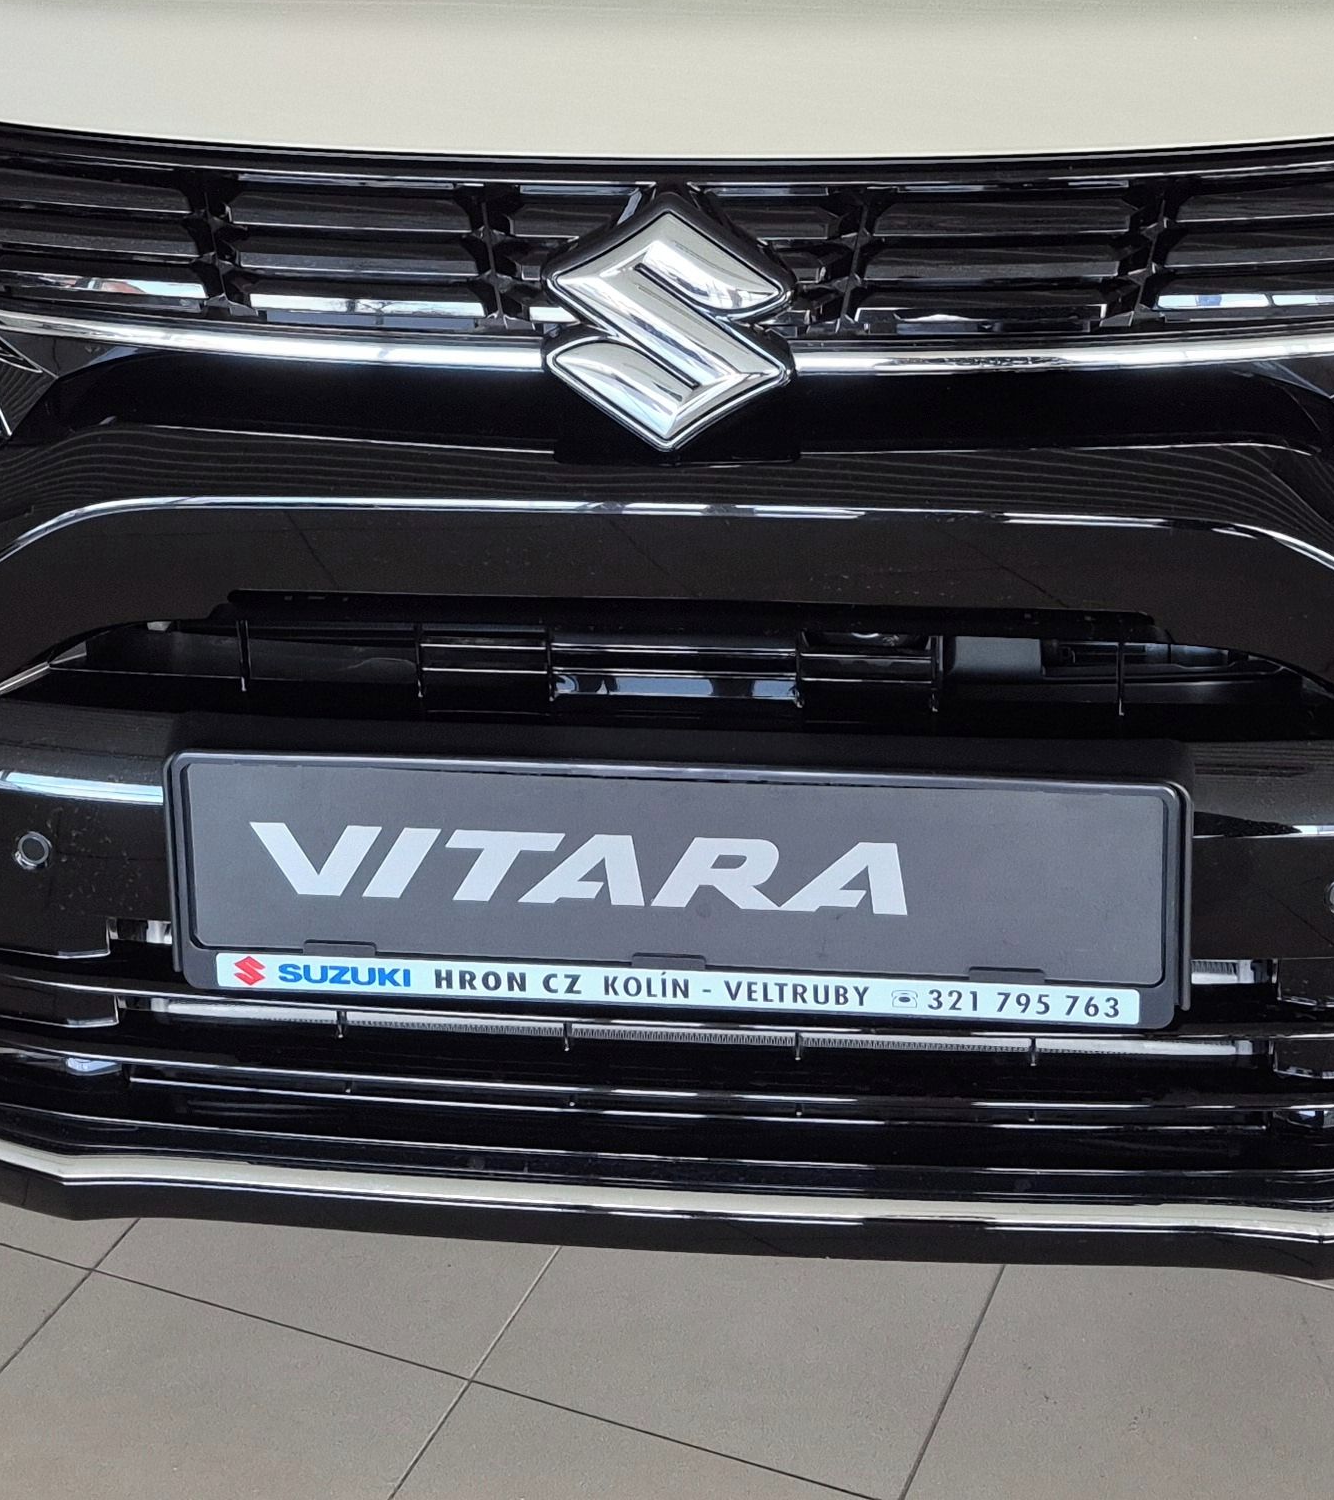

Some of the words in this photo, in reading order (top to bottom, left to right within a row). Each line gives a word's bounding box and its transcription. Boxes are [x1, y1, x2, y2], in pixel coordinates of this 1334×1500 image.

[250, 821, 908, 916] VITARA
[278, 963, 411, 988] SUZUKI
[434, 968, 527, 992] HRON
[542, 973, 582, 995] CZ
[603, 971, 690, 999] KOLÍN
[723, 980, 870, 1007] VELTRUBY
[927, 988, 979, 1012] 321
[996, 991, 1051, 1015] 795
[1064, 994, 1120, 1018] 763
